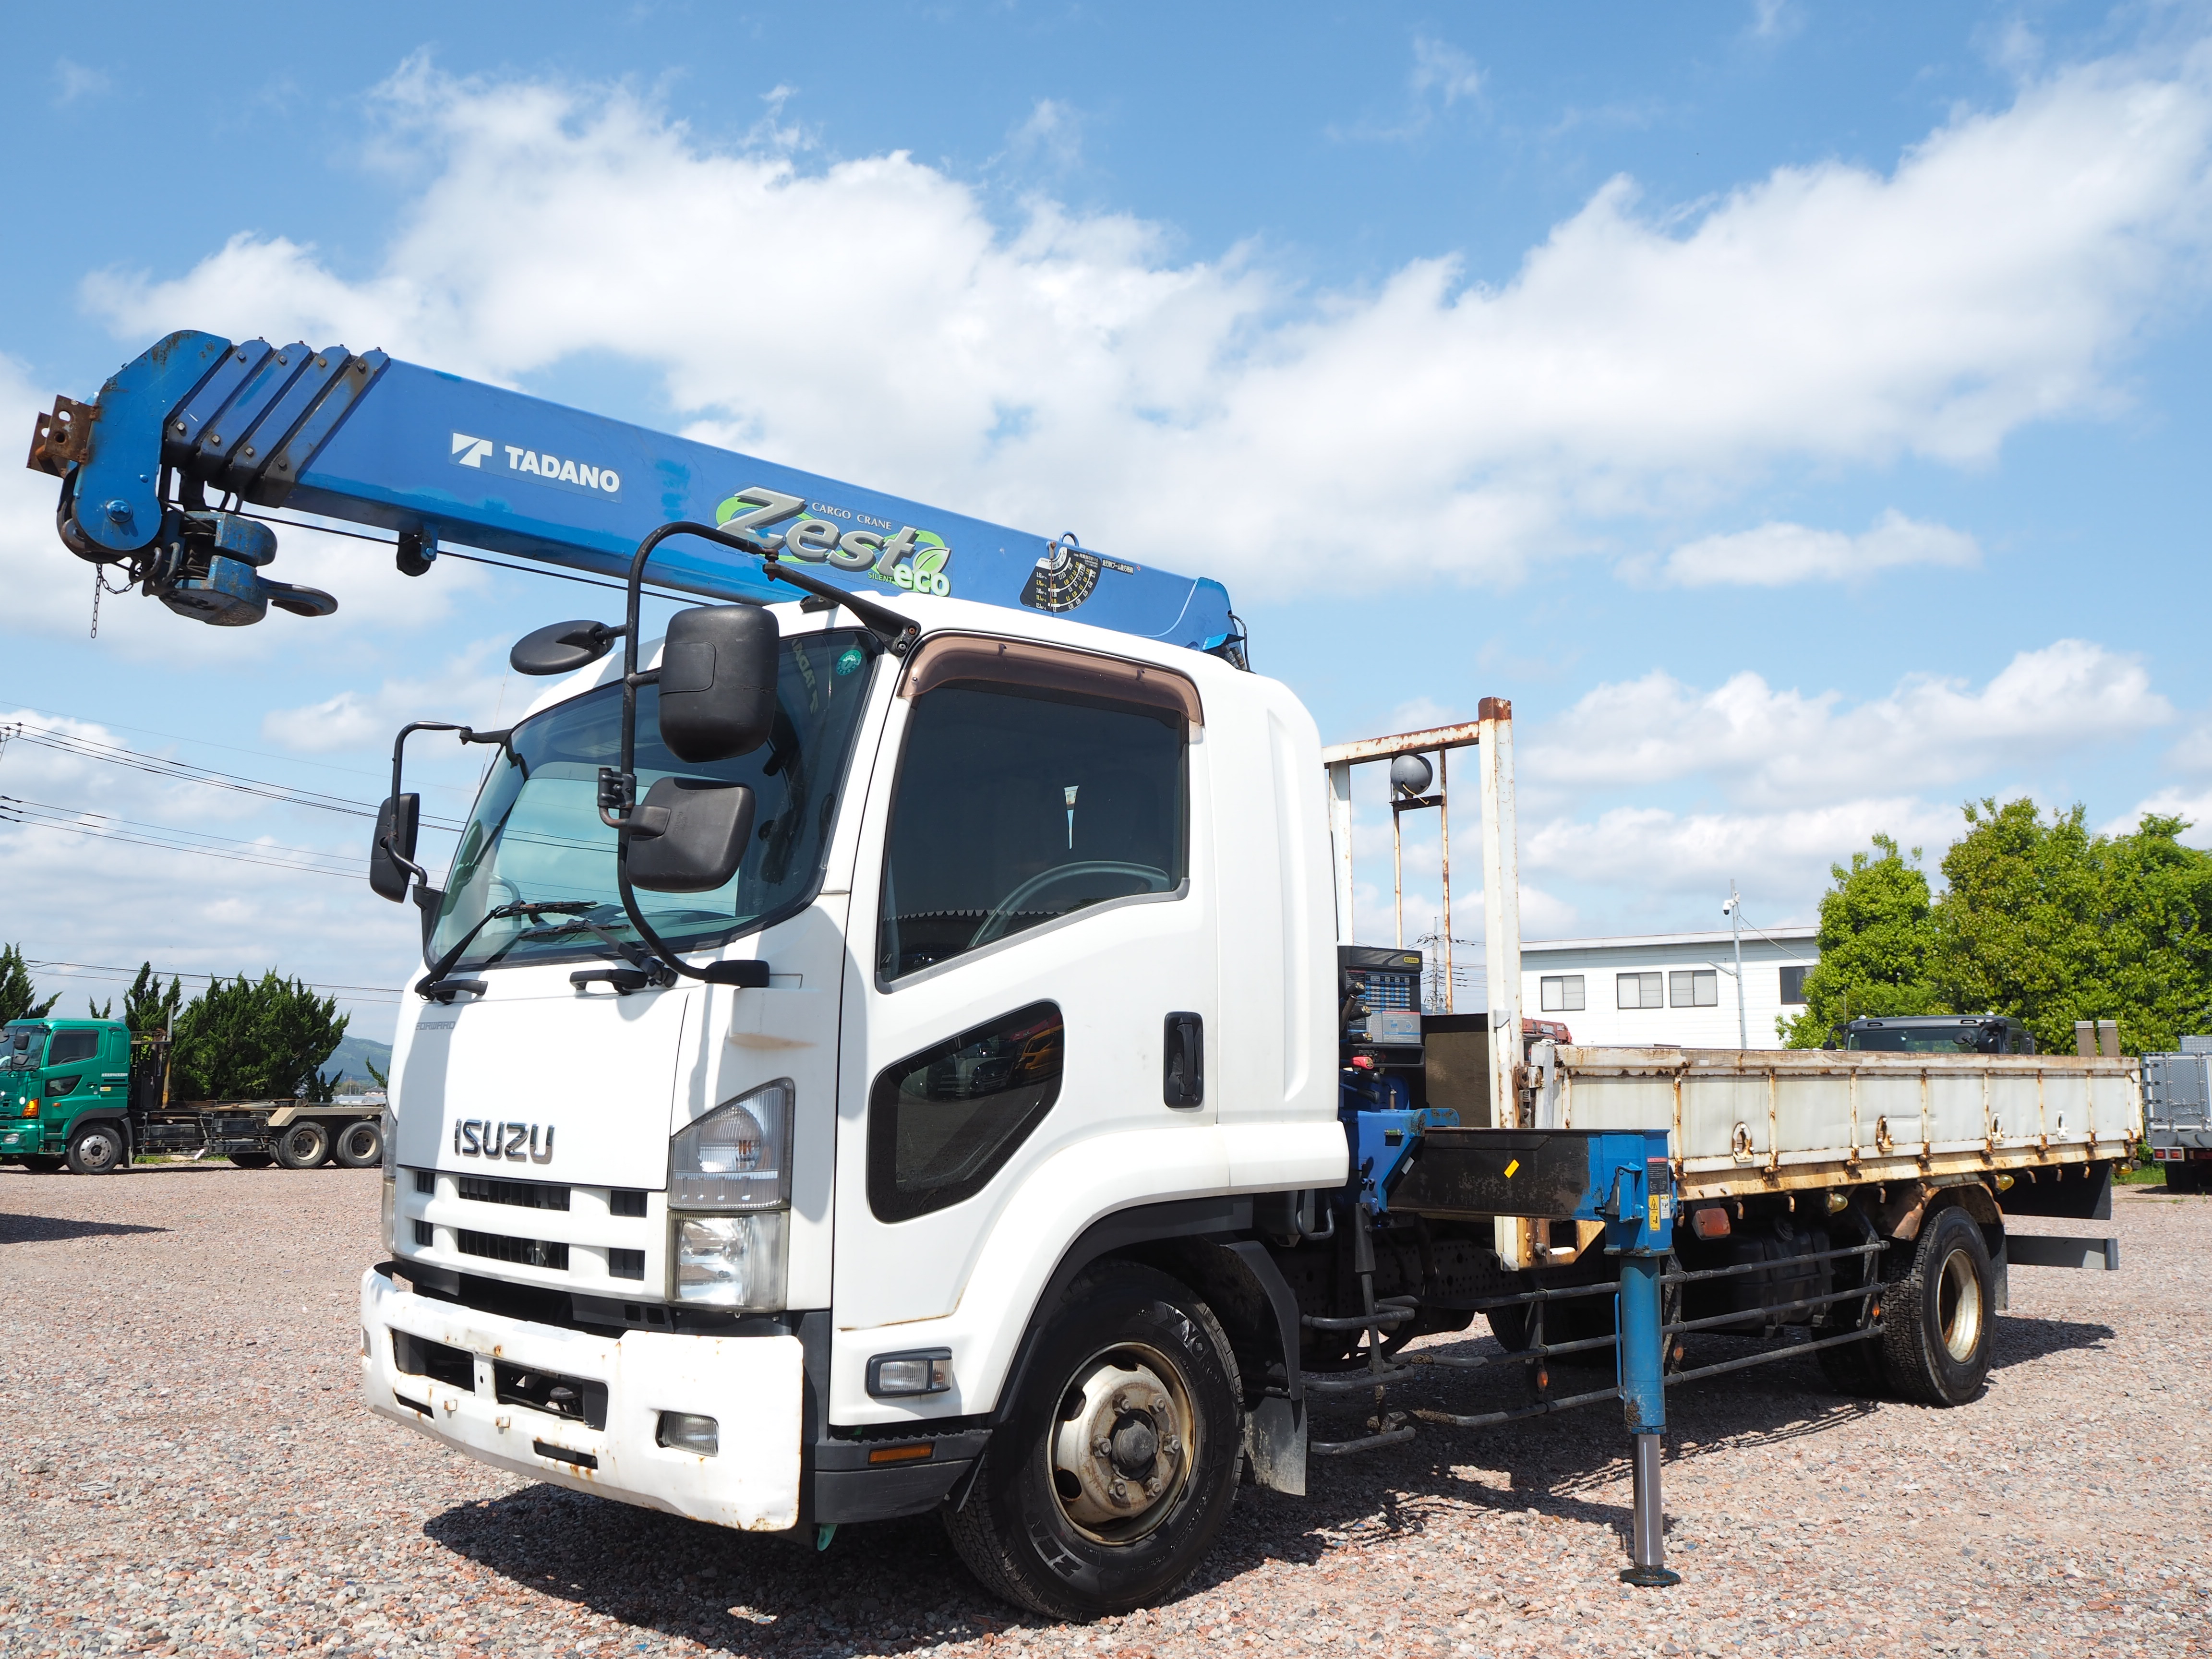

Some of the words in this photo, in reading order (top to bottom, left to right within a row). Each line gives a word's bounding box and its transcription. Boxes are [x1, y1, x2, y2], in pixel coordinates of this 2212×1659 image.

[505, 445, 620, 493] TADANO
[716, 486, 917, 577] Zest
[812, 502, 852, 519] CARGO
[856, 514, 892, 530] CRANE
[867, 571, 894, 583] SILENT
[894, 564, 951, 597] eco
[416, 1021, 456, 1031] FORWARD
[454, 1119, 555, 1165] ISUZU
[1025, 1512, 1083, 1577] ZEN
